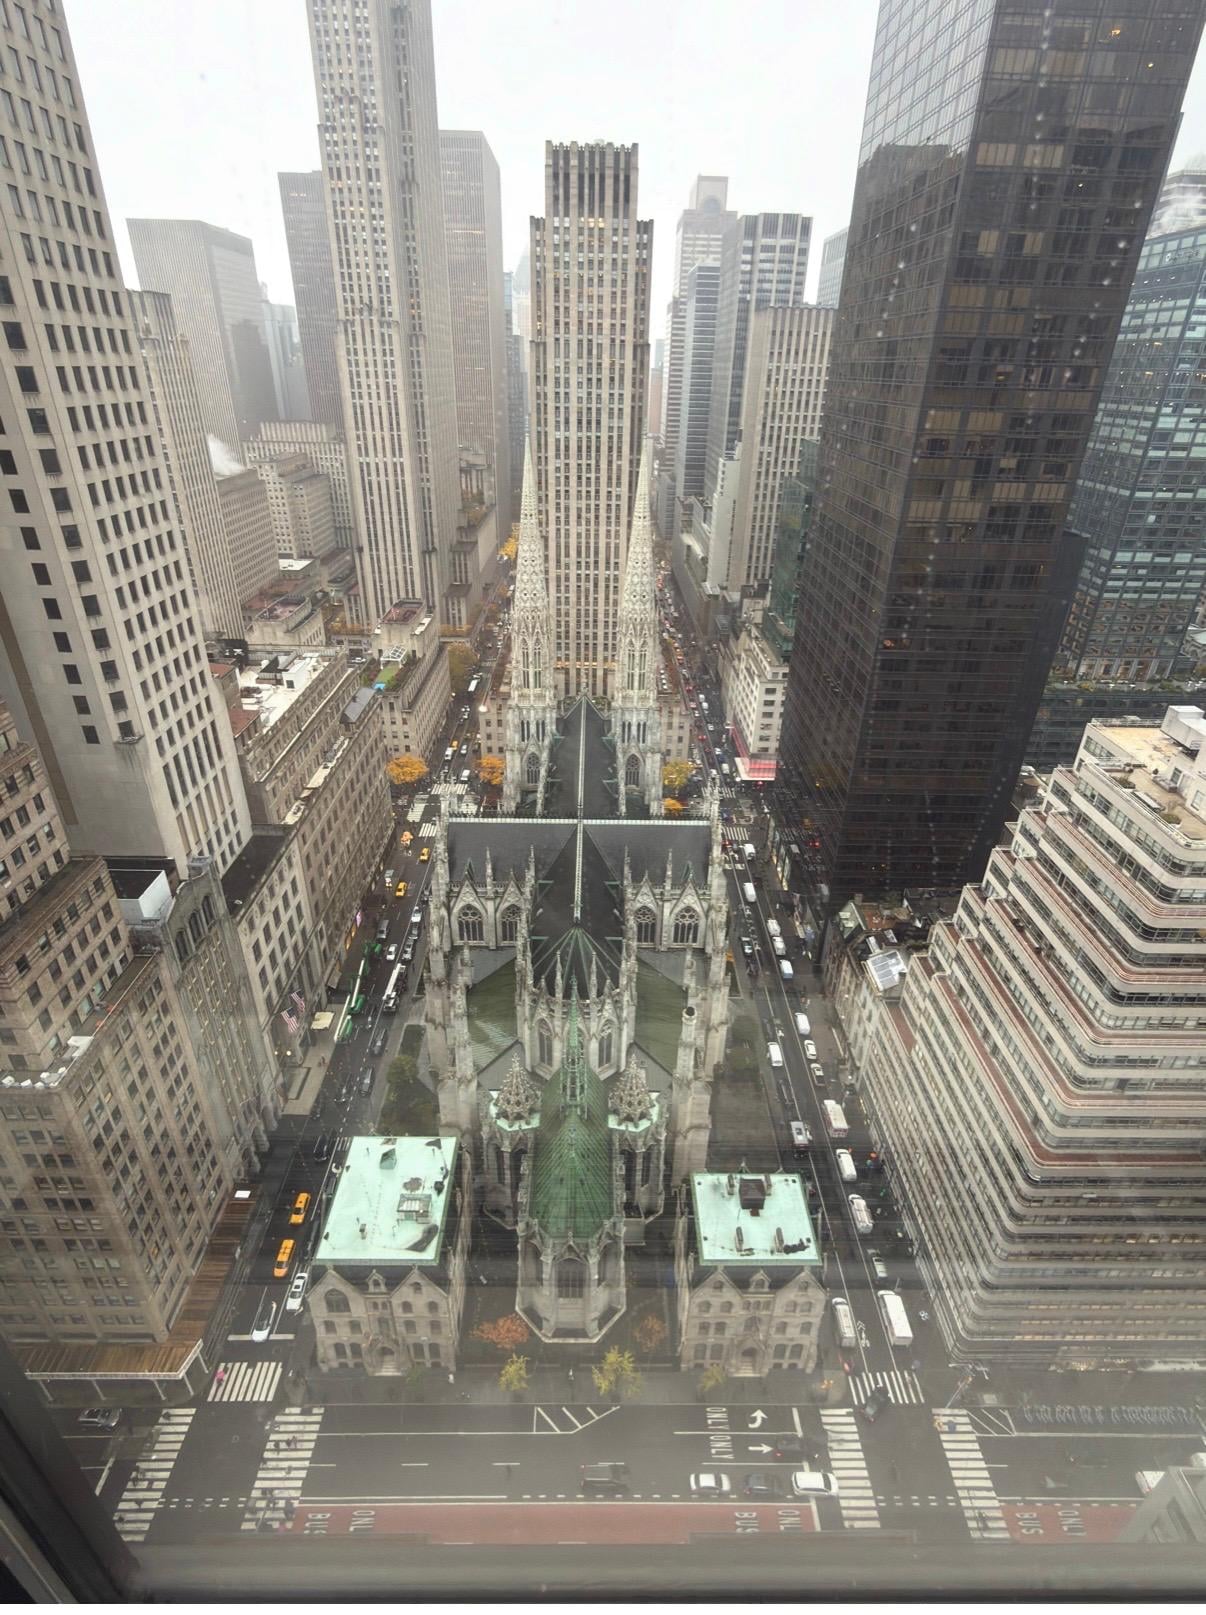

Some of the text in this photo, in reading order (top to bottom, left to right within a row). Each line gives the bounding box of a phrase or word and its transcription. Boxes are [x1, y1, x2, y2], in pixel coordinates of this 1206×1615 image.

[705, 1407, 730, 1430] ONLY
[709, 1435, 735, 1459] ONLY
[349, 1510, 376, 1532] ONL
[777, 1509, 803, 1531] ONL
[1015, 1512, 1044, 1535] BUS
